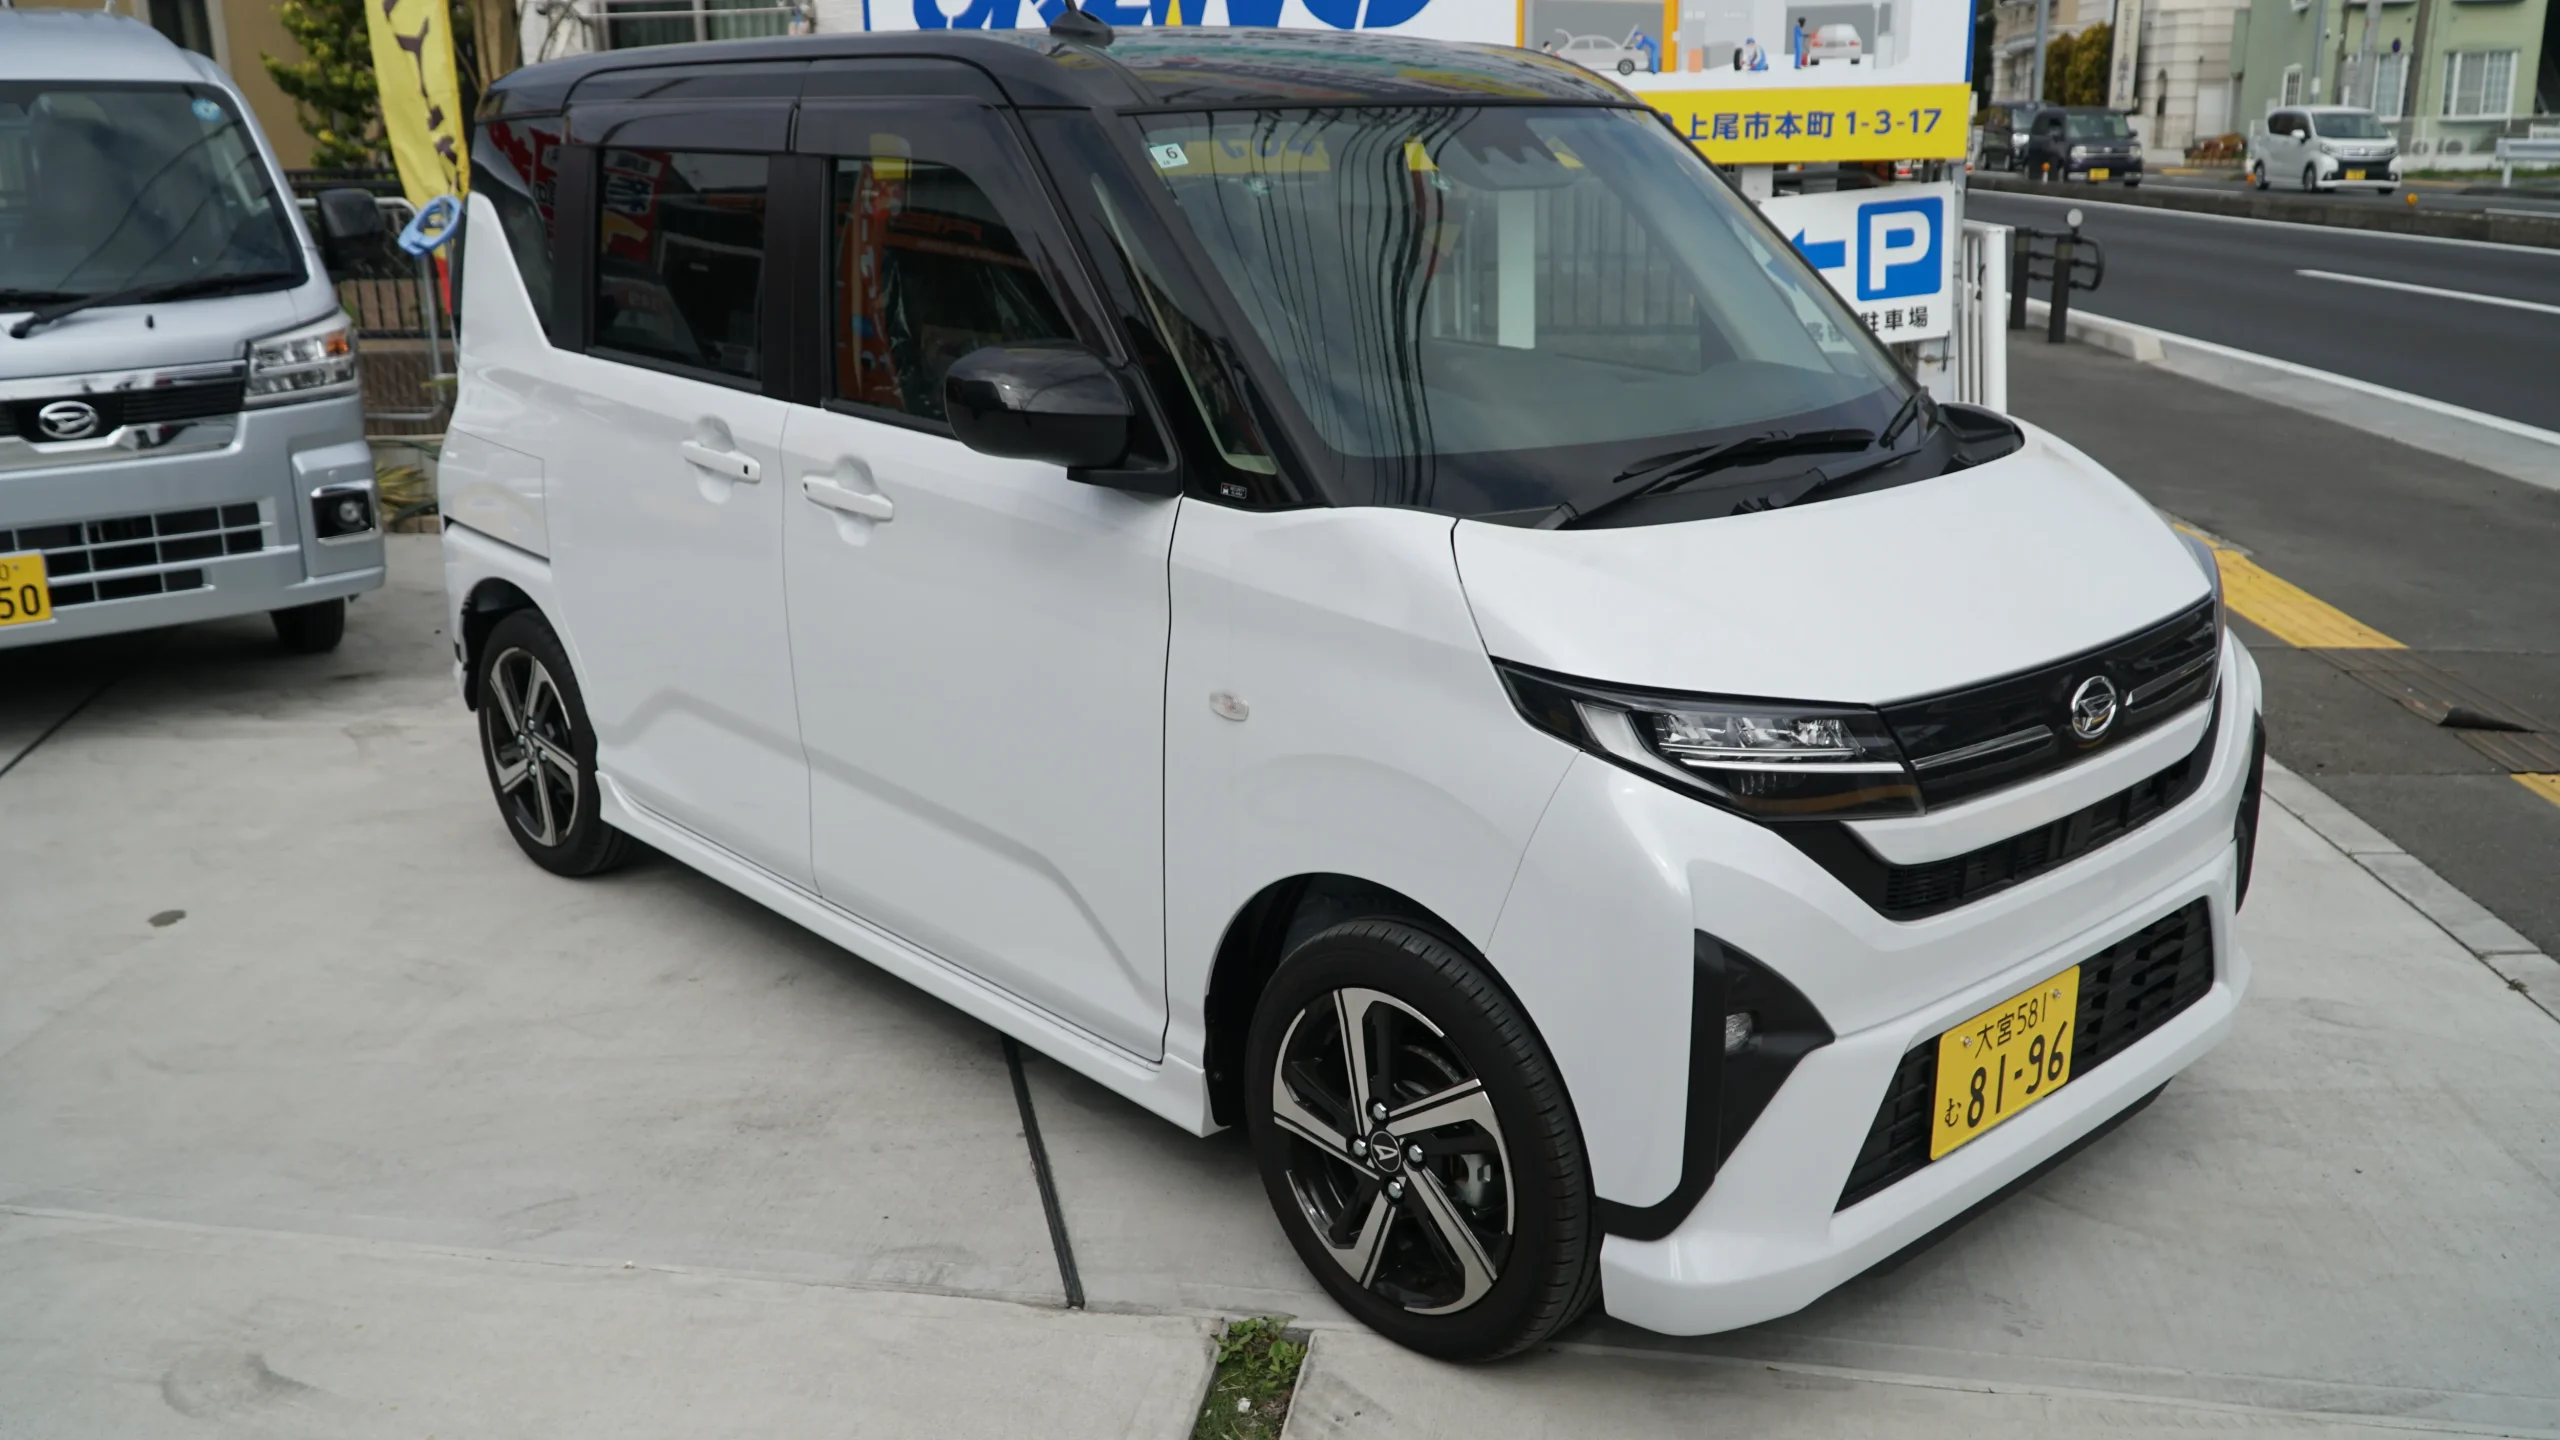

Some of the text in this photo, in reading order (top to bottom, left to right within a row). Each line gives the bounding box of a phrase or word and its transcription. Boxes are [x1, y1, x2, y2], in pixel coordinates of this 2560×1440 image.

[1688, 107, 1943, 140] 上尾市本町 1-3-17
[1166, 147, 1178, 159] 6
[1868, 210, 1931, 292] P
[1859, 305, 1929, 333] 駐車場
[1943, 1019, 2068, 1129] む 81-96
